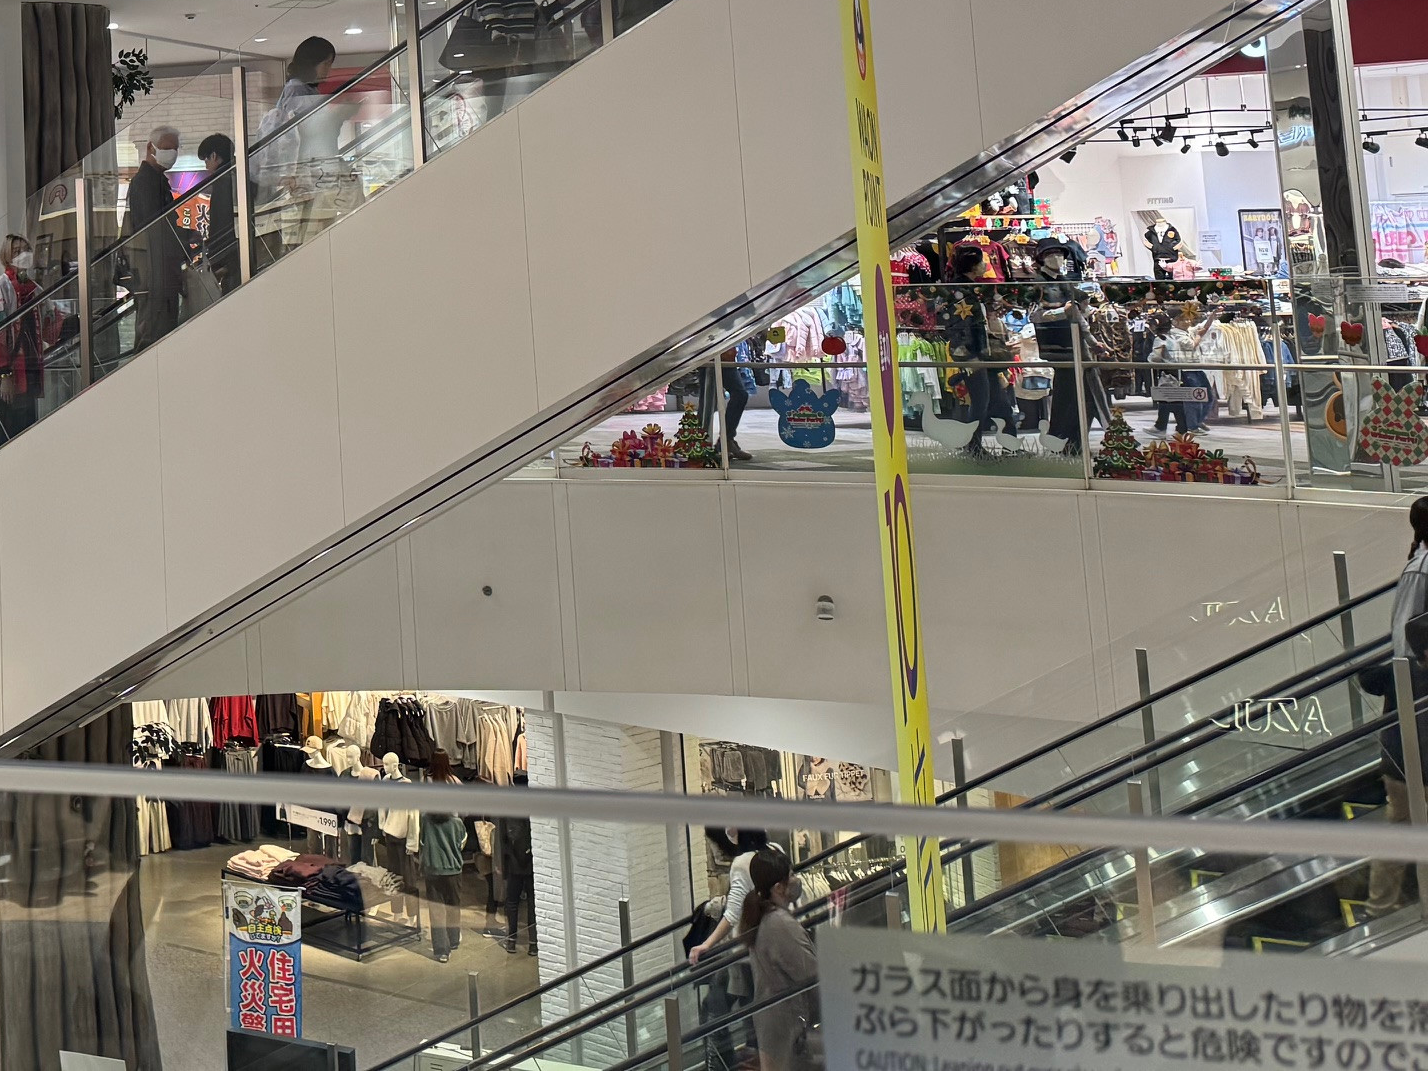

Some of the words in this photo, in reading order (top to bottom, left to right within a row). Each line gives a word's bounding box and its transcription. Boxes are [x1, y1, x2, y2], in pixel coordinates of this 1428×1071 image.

[855, 96, 879, 166] WAON
[861, 167, 884, 230] POINT
[802, 773, 824, 782] FAUX
[824, 772, 839, 780] FUR
[247, 923, 284, 937] 自主点検
